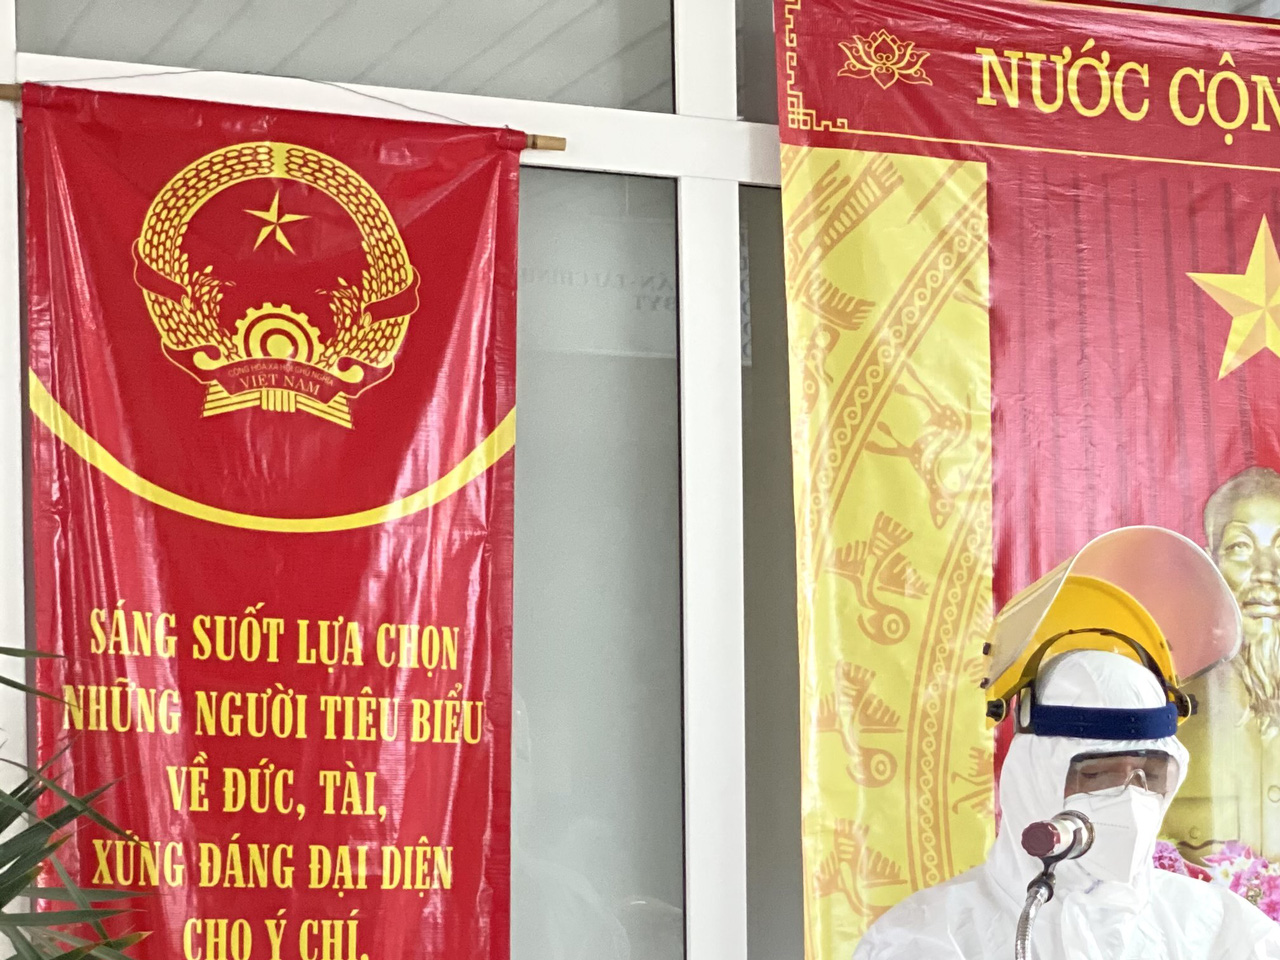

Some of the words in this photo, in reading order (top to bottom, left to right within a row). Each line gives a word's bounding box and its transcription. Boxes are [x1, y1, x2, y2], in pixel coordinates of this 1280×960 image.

[975, 38, 1149, 121] NƯỚC
[283, 375, 321, 396] NAM
[90, 599, 177, 657] SÁNG
[192, 602, 285, 663] SUỐT
[297, 615, 364, 673] LỰA
[376, 622, 458, 678] CHỌN
[63, 677, 180, 734] NHỮNG
[195, 682, 308, 739] NGƯỜI
[319, 686, 394, 741] TIÊU
[411, 684, 484, 745] BIỂU
[167, 751, 209, 812] VỀ
[223, 758, 306, 820] ĐỨC,
[319, 761, 387, 820] TÀI,
[92, 830, 184, 886] XỨNG
[199, 833, 295, 889] ĐÁNG
[308, 844, 368, 898] ĐẠI
[381, 835, 453, 898] DIỆN
